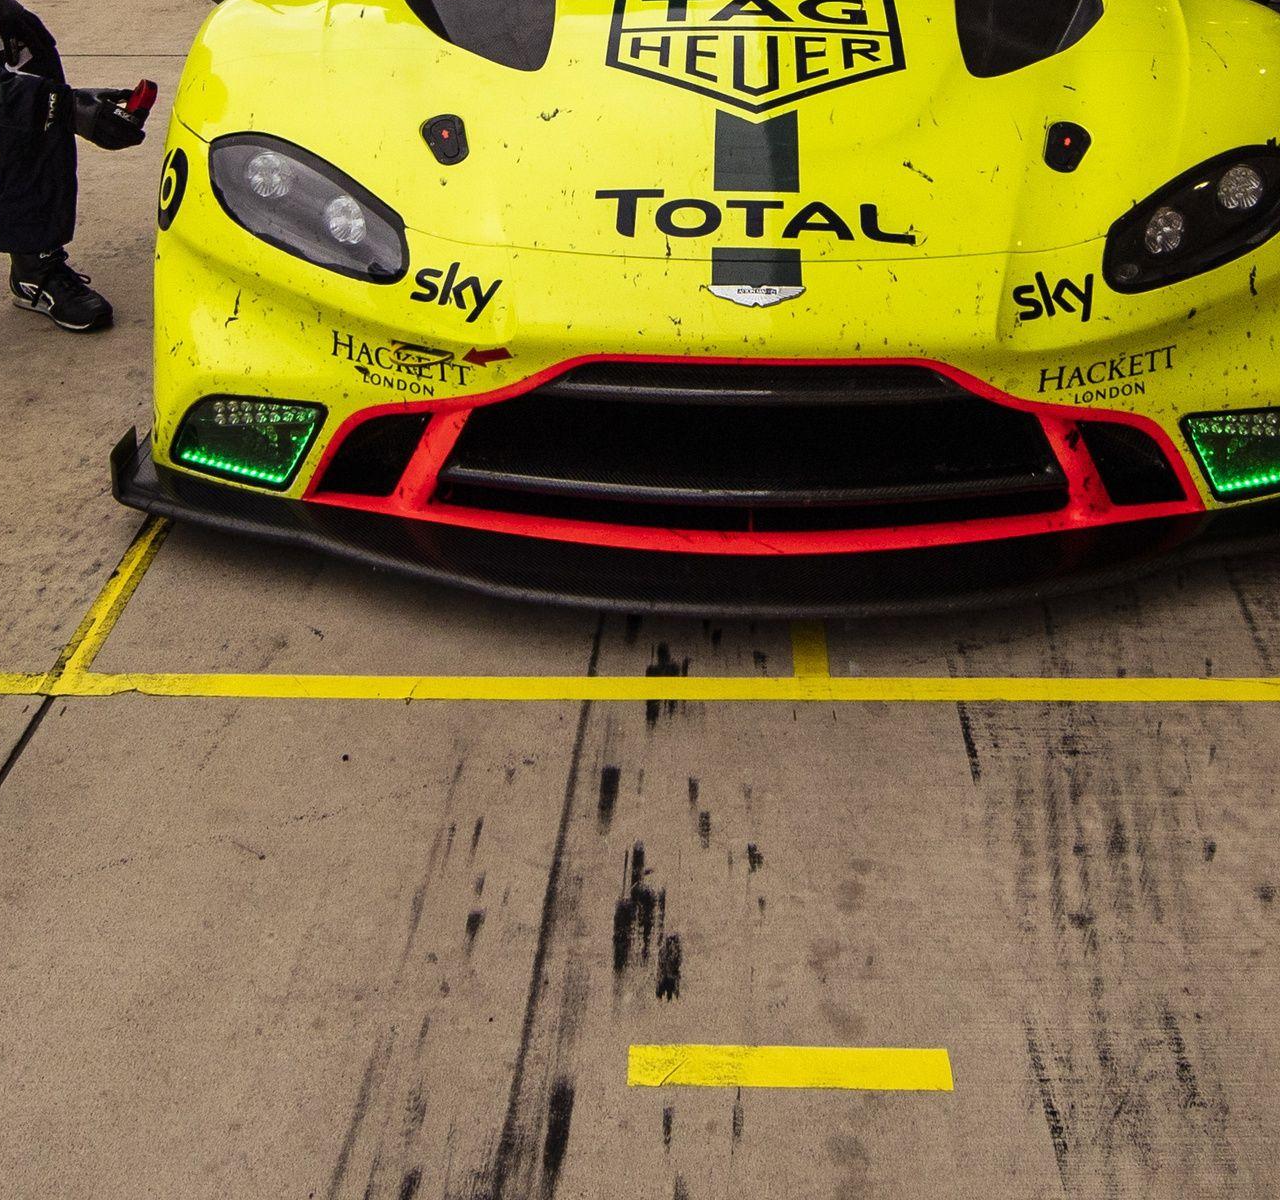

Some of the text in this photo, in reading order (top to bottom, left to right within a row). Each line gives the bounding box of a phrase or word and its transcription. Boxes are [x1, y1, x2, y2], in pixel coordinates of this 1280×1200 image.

[629, 35, 880, 97] HEUER
[595, 189, 916, 245] TOTAL
[410, 262, 502, 323] sky
[1012, 271, 1095, 324] sky
[331, 330, 473, 387] HACKETT
[361, 370, 435, 398] LONDON
[1037, 344, 1178, 395] HACKETT
[1073, 380, 1148, 405] LONDON
